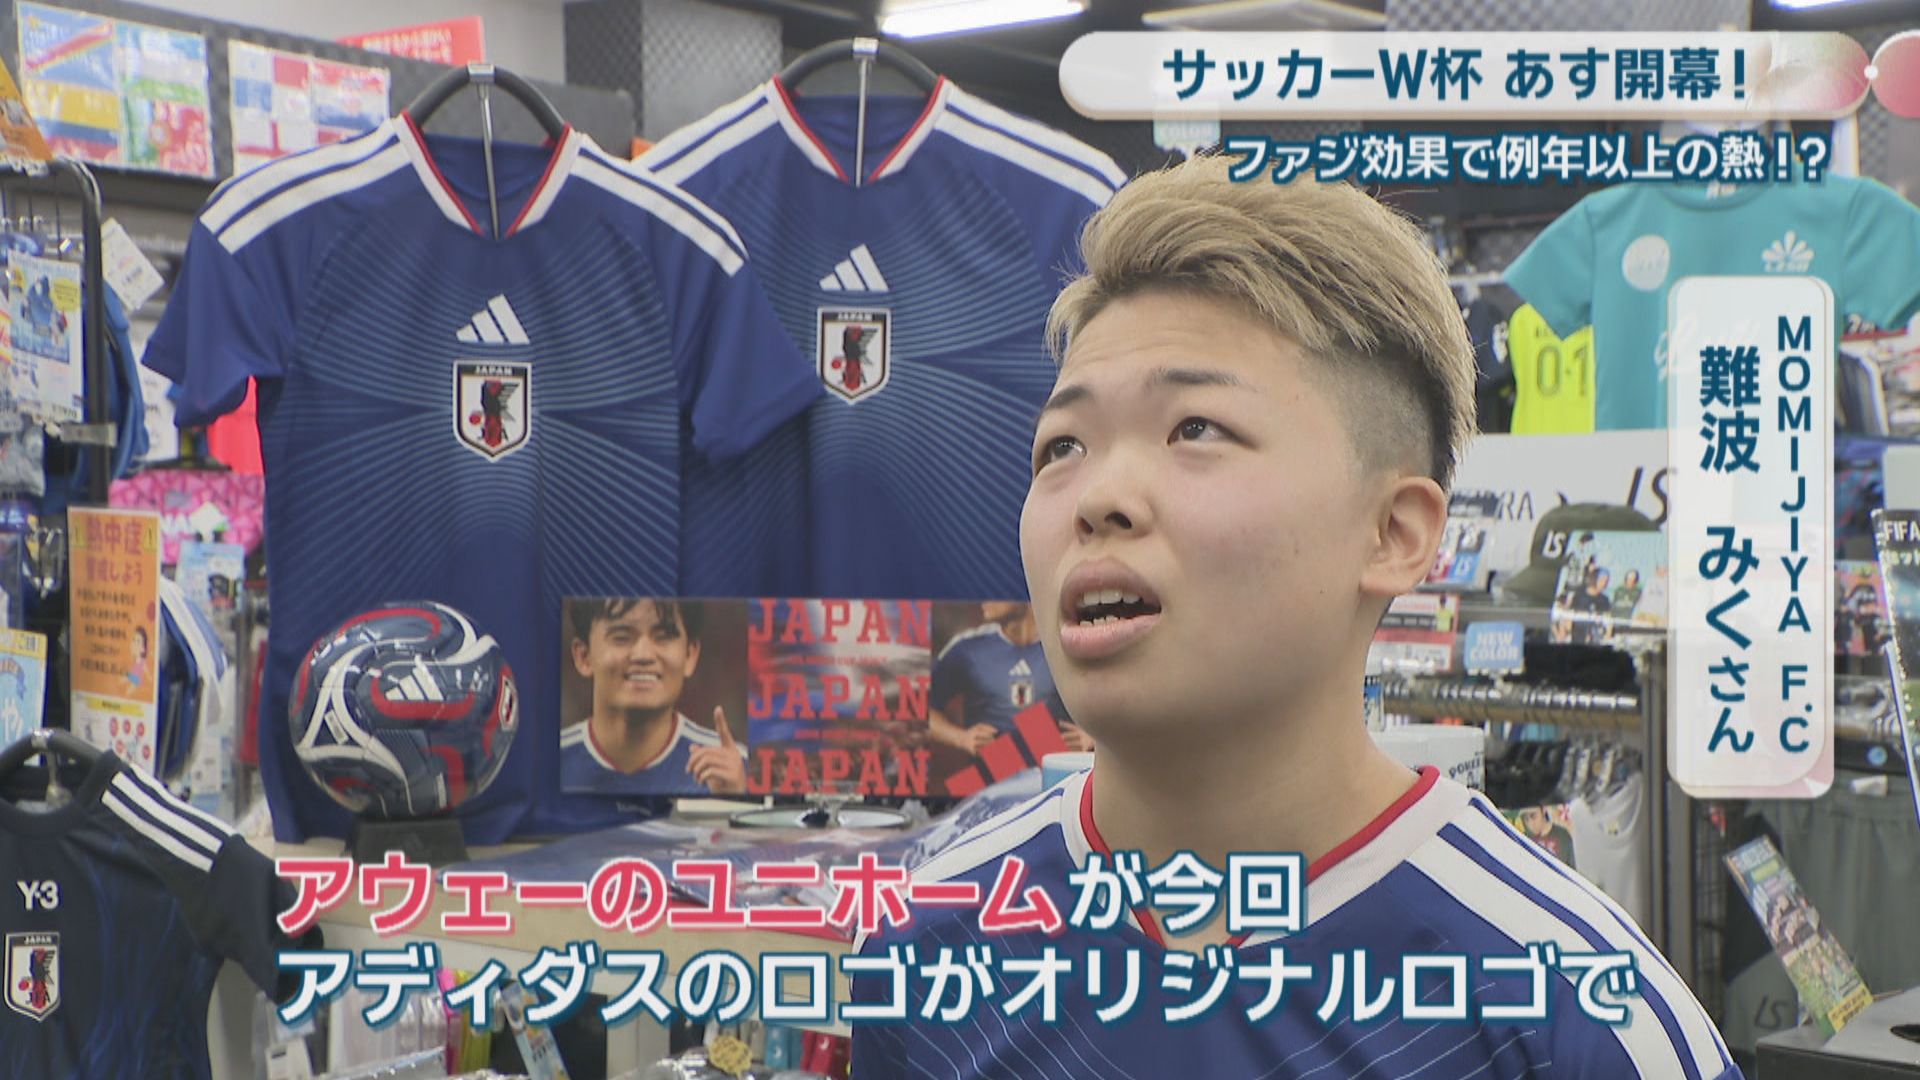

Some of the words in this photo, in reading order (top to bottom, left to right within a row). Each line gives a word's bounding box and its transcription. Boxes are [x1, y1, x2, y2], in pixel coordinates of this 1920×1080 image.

[748, 598, 932, 648] JAPAN
[1476, 631, 1514, 646] NEW
[1469, 647, 1520, 661] COLOR
[748, 672, 932, 721] JAPAN
[747, 747, 931, 797] JAPAN
[24, 936, 52, 945] JAPAN
